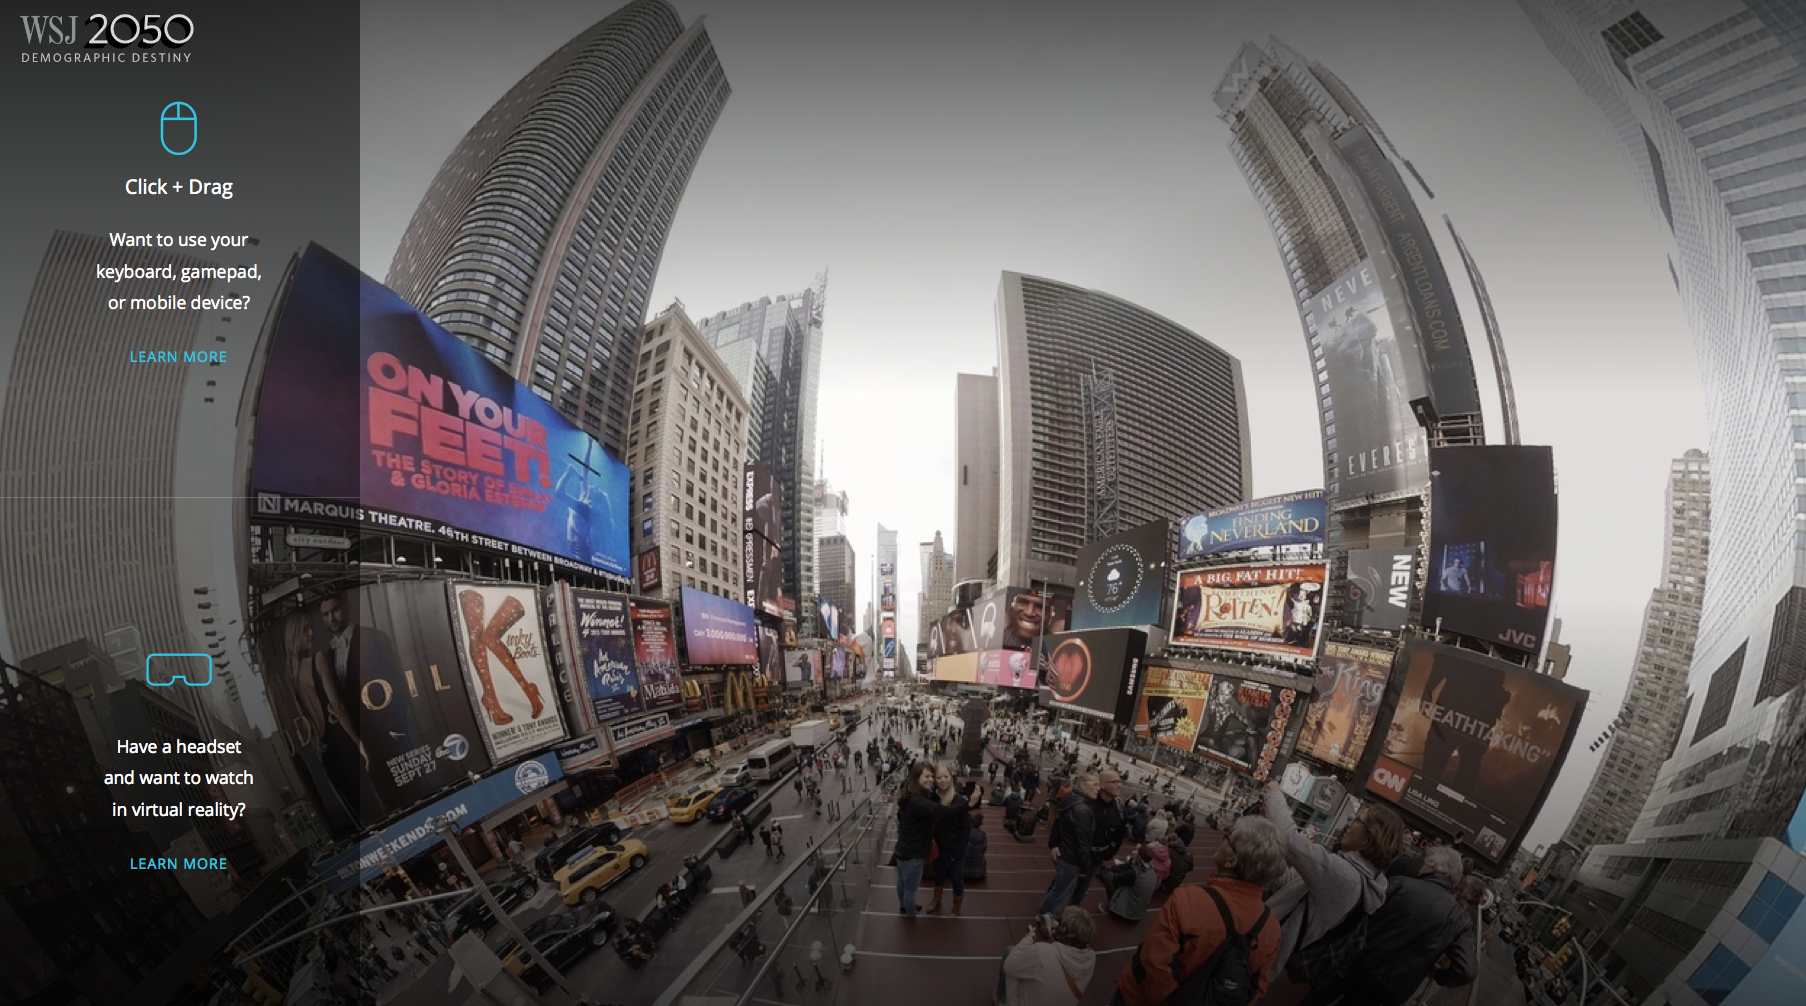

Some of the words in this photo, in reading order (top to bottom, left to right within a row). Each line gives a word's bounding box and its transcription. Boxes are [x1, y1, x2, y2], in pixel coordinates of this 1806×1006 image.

[1397, 231, 1451, 351] ARGENTLOANS.COM
[367, 350, 444, 411] ON
[447, 379, 549, 450] YOUR
[369, 386, 552, 488] FEET!
[371, 449, 414, 473] THE
[420, 457, 478, 487] STORY
[484, 473, 506, 491] OF
[390, 470, 405, 488] &
[411, 474, 479, 502] GLORIA
[1283, 494, 1303, 502] NEW
[284, 498, 364, 521] MARQUIS
[437, 525, 470, 543] 46TH
[471, 534, 509, 552] STREET
[511, 545, 552, 563] BETWEEN
[1209, 516, 1320, 544] NEVERLAND
[1233, 508, 1292, 527] FINDING
[1194, 574, 1203, 584] A
[1236, 570, 1261, 582] FAT
[1388, 554, 1412, 608] NEW
[1203, 590, 1285, 622] ROTTEN!
[1211, 588, 1276, 597] SOMETHING
[580, 611, 625, 630] Winner!
[546, 592, 573, 703] PALACE
[1498, 628, 1536, 649] JVC
[361, 664, 450, 711] OIL
[1127, 657, 1139, 696] SAMSUNG
[1321, 662, 1386, 706] King
[643, 683, 680, 701] Matilda
[386, 752, 405, 768] NEW
[389, 753, 432, 778] SUNDAY
[394, 769, 422, 787] SEPT
[424, 760, 438, 775] 27
[1374, 768, 1406, 793] CNN
[1407, 786, 1422, 801] LISA
